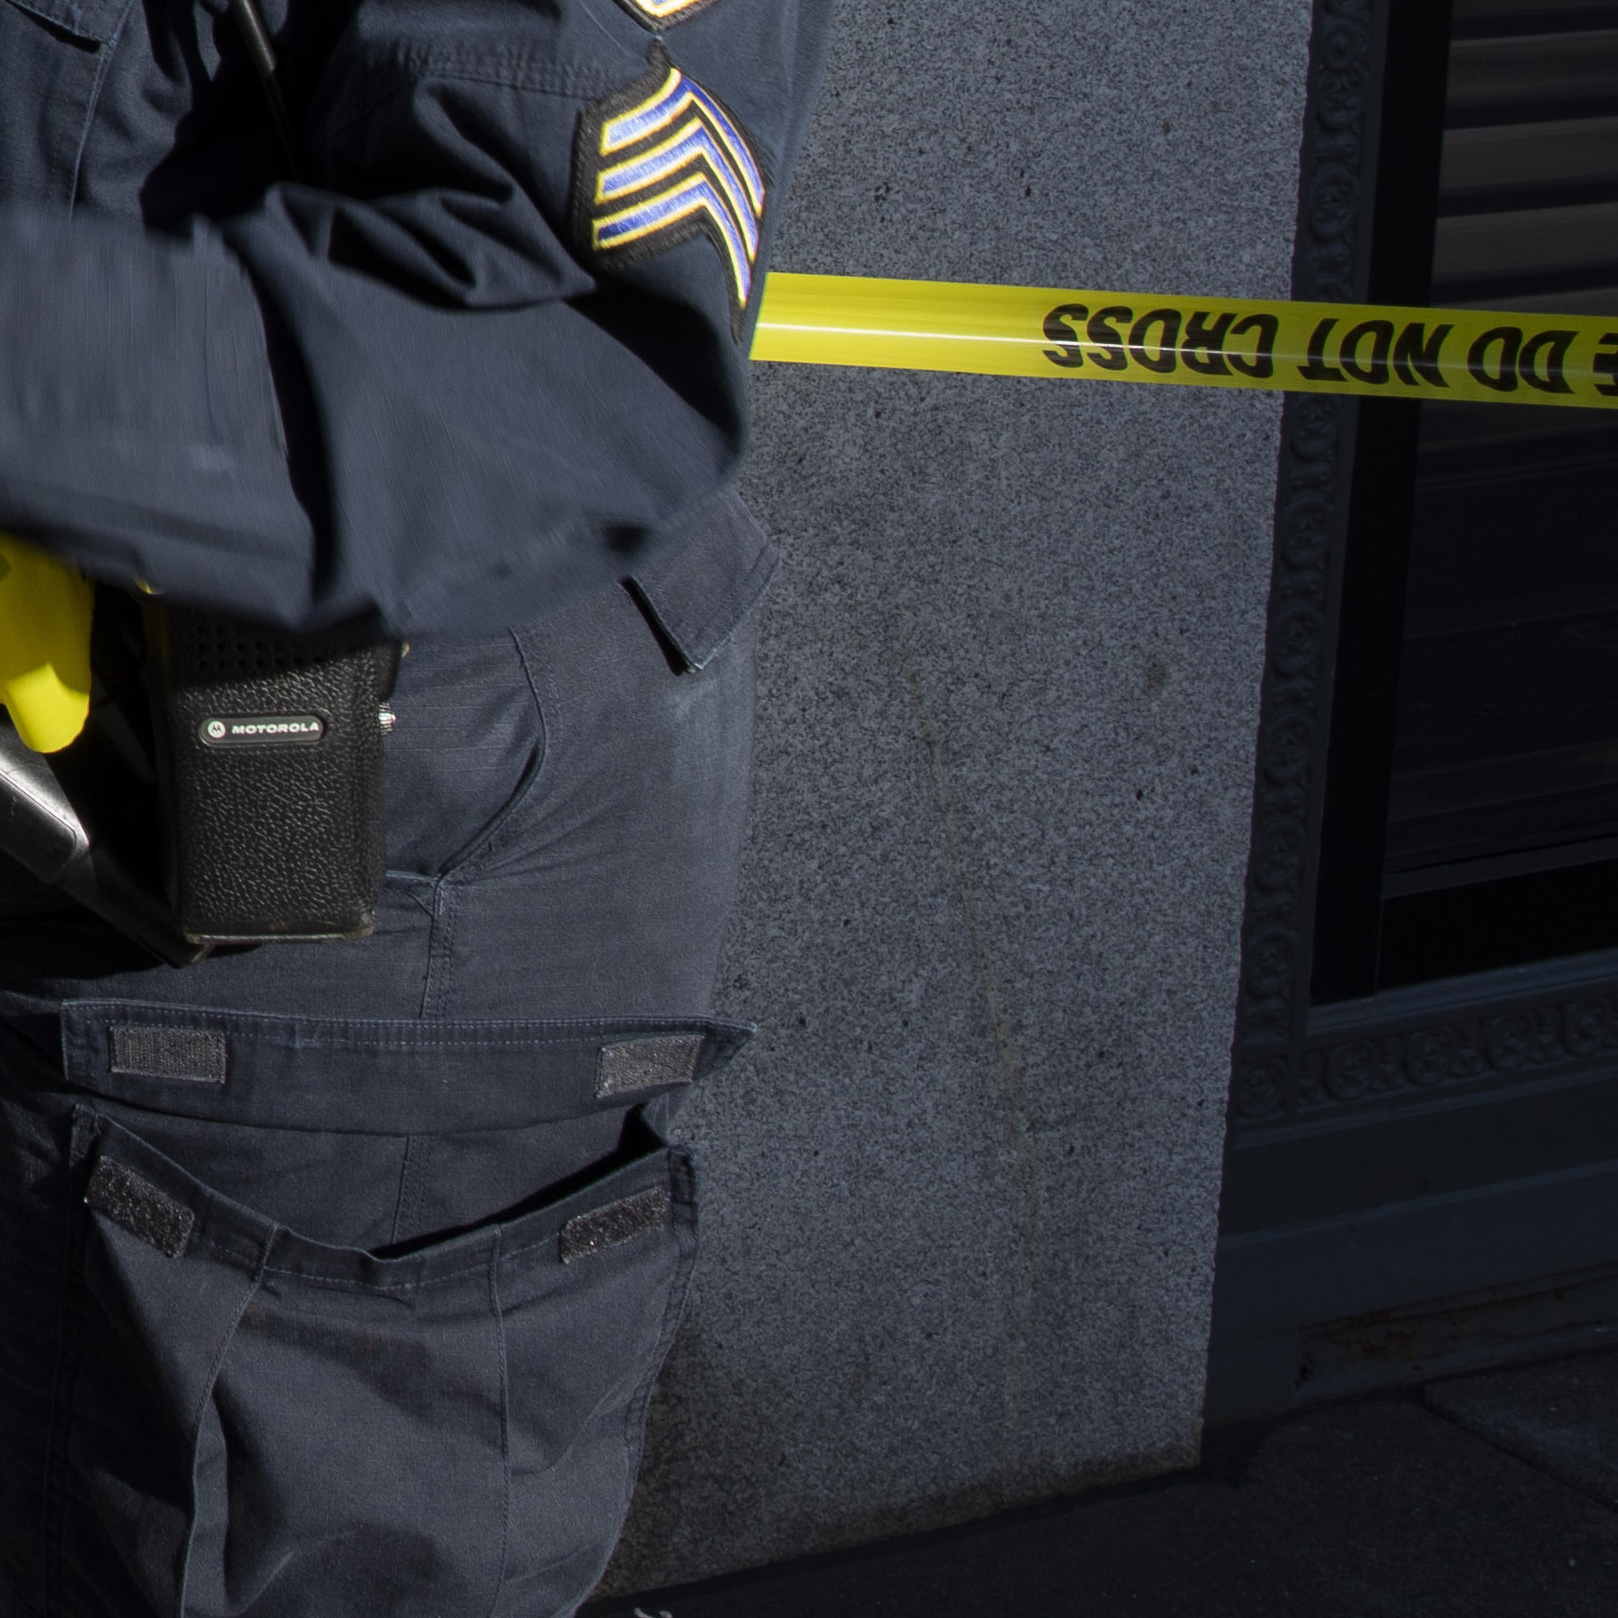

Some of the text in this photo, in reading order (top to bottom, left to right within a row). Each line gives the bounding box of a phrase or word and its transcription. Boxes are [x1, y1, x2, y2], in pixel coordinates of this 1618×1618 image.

[1042, 303, 1279, 379] CROSS
[1297, 318, 1456, 388] NOT
[1467, 326, 1579, 395] DO
[231, 722, 319, 734] MOTOROLA
